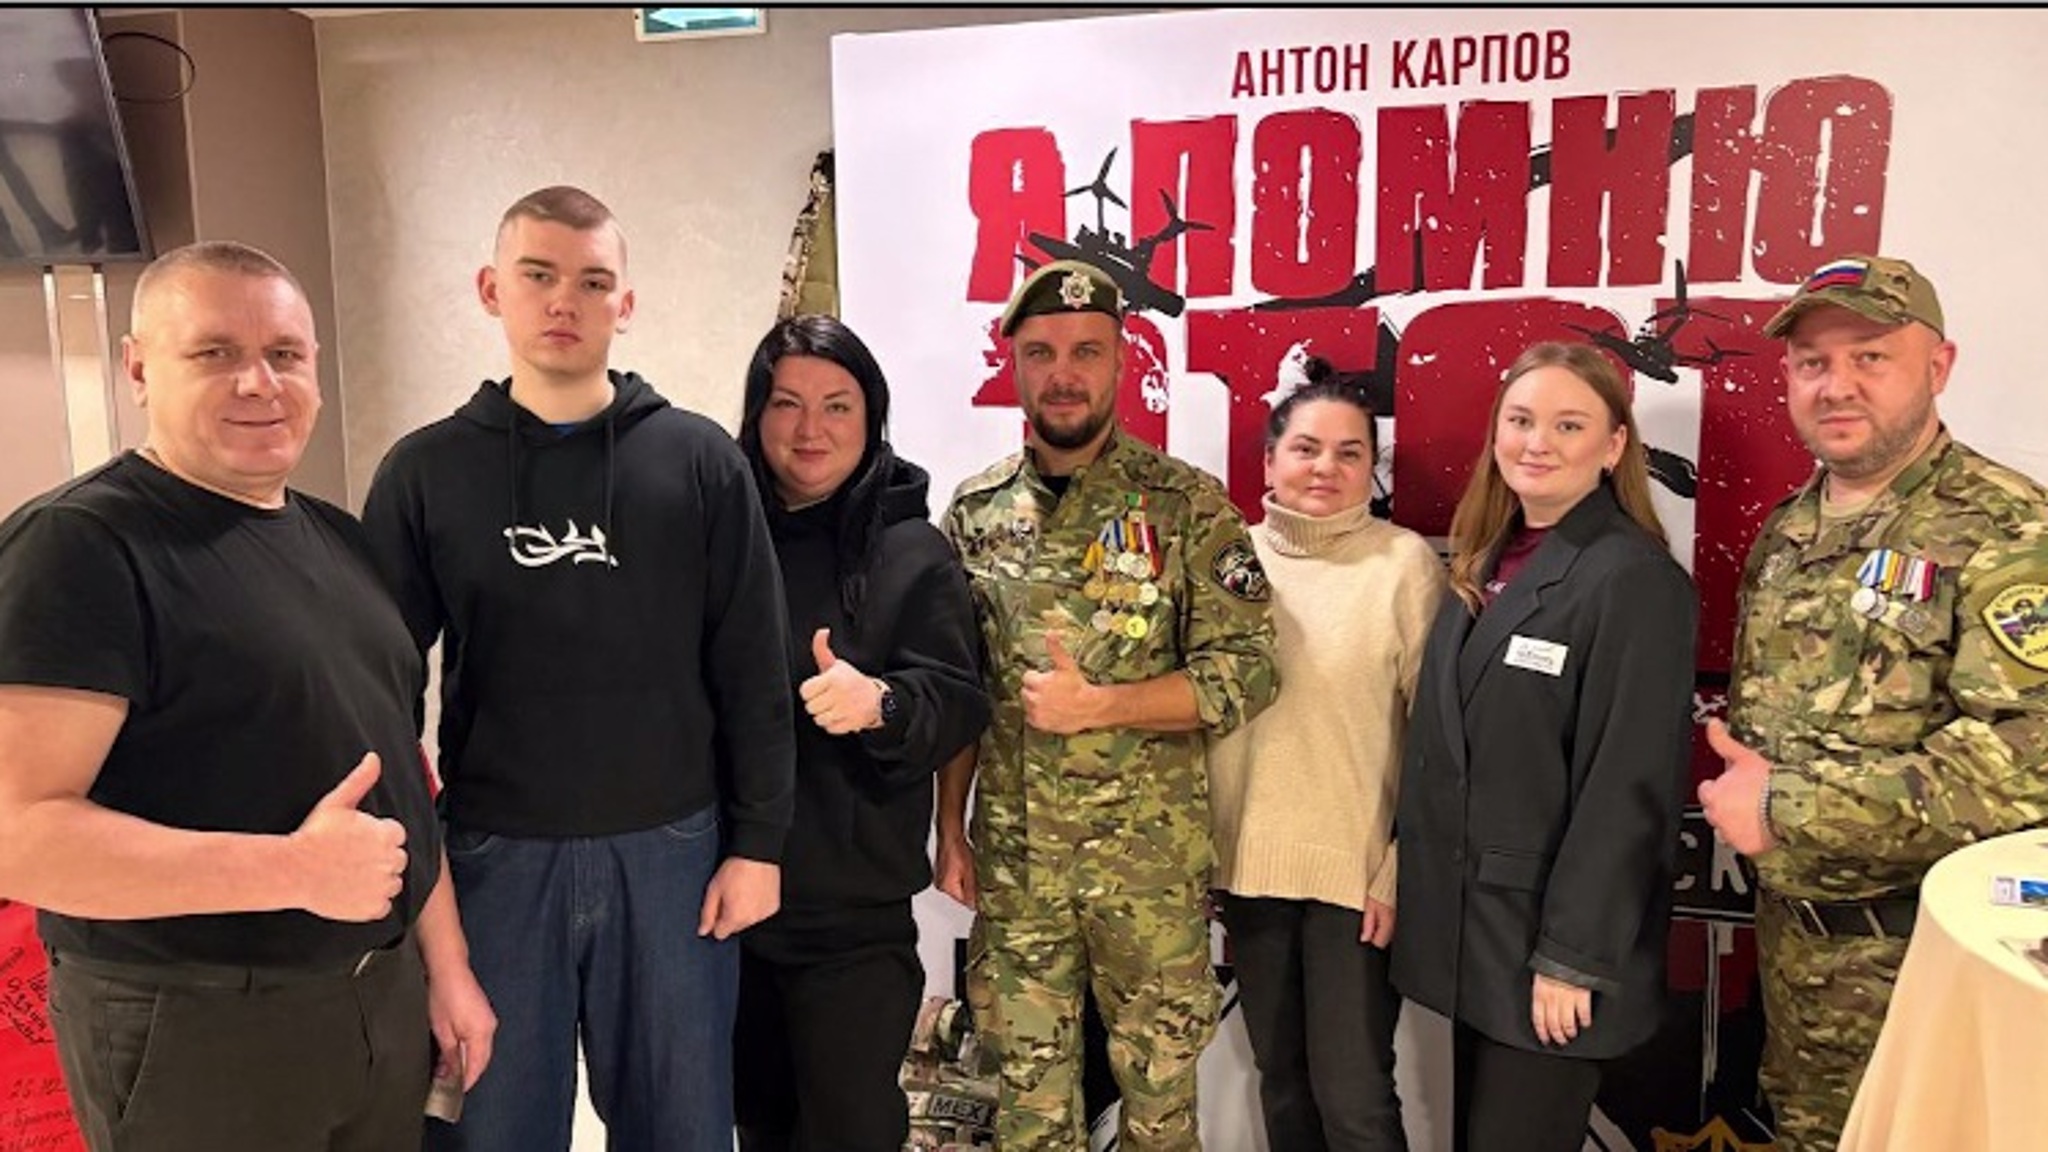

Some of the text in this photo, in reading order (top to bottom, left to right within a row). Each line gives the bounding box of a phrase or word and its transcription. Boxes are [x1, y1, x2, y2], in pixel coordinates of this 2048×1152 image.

[1231, 30, 1571, 98] АНТОН КАРПОВ
[966, 75, 1893, 302] Я ПОМНЮ
